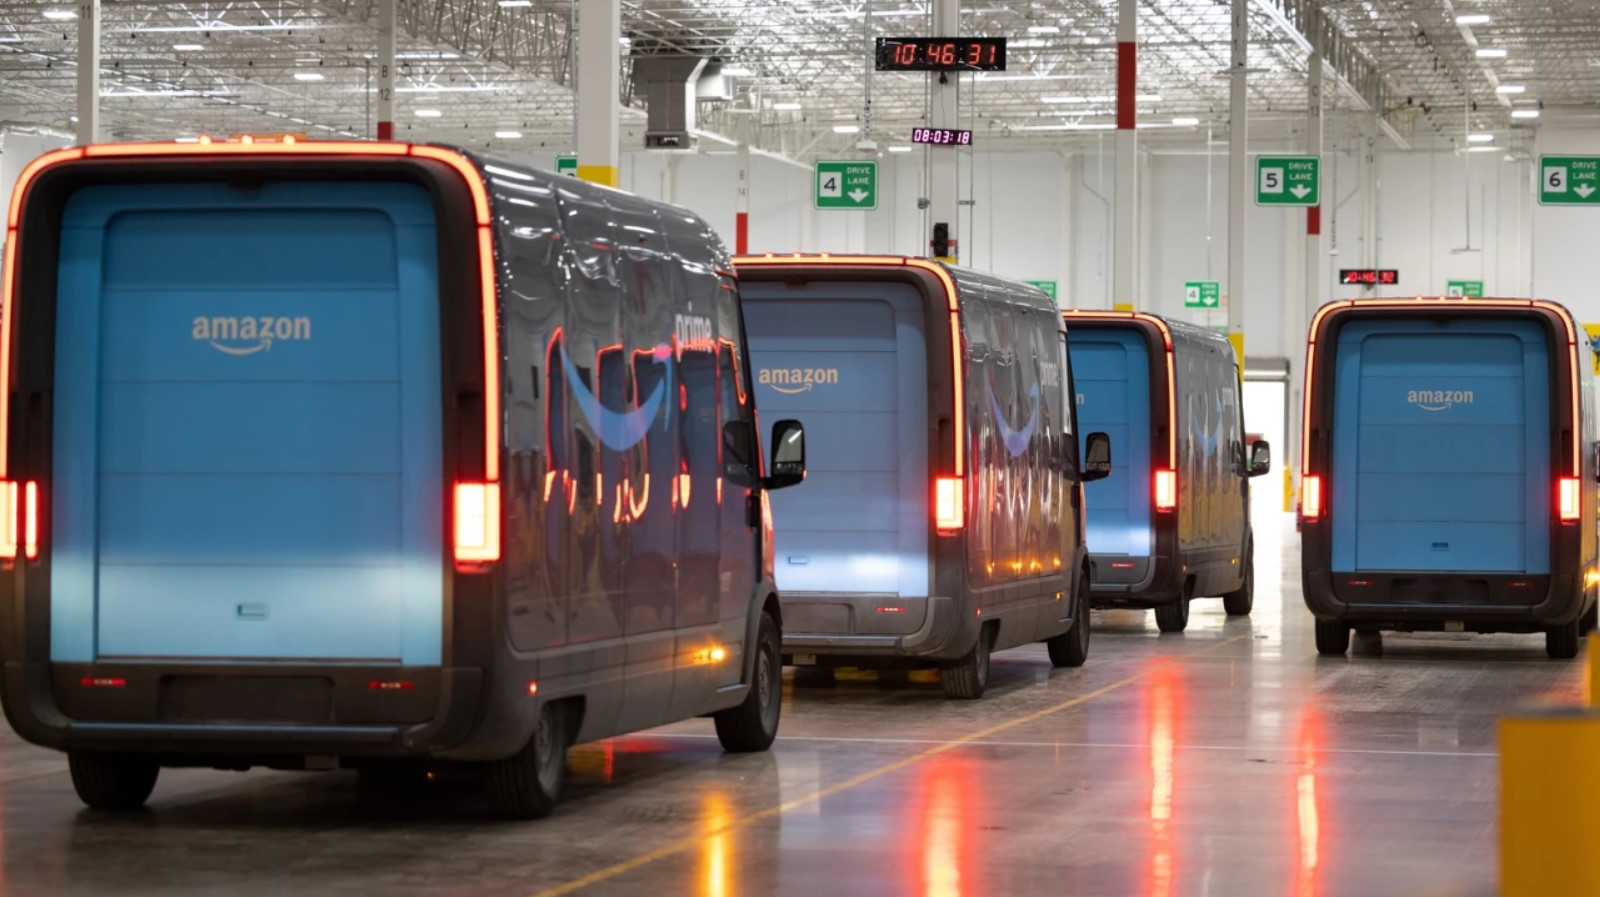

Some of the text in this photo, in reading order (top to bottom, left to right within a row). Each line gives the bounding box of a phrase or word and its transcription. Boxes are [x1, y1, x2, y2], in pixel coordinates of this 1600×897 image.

[81, 4, 91, 19] 11
[894, 44, 996, 65] 10:46:31
[382, 65, 388, 78] B
[380, 88, 390, 101] 12
[914, 129, 970, 144] 08:03:18
[847, 166, 871, 174] DRIVE
[1288, 162, 1313, 170] DRIVE
[1572, 161, 1597, 169] DRIVE
[847, 177, 870, 185] LANE
[1266, 172, 1278, 188] 5
[1289, 173, 1312, 181] LANE
[1549, 171, 1561, 188] 6
[1572, 172, 1596, 180] LANE
[823, 177, 837, 192] 4
[192, 316, 311, 340] amazon
[675, 300, 712, 362] prime
[759, 368, 839, 384] amazon
[1407, 390, 1474, 403] amazon
